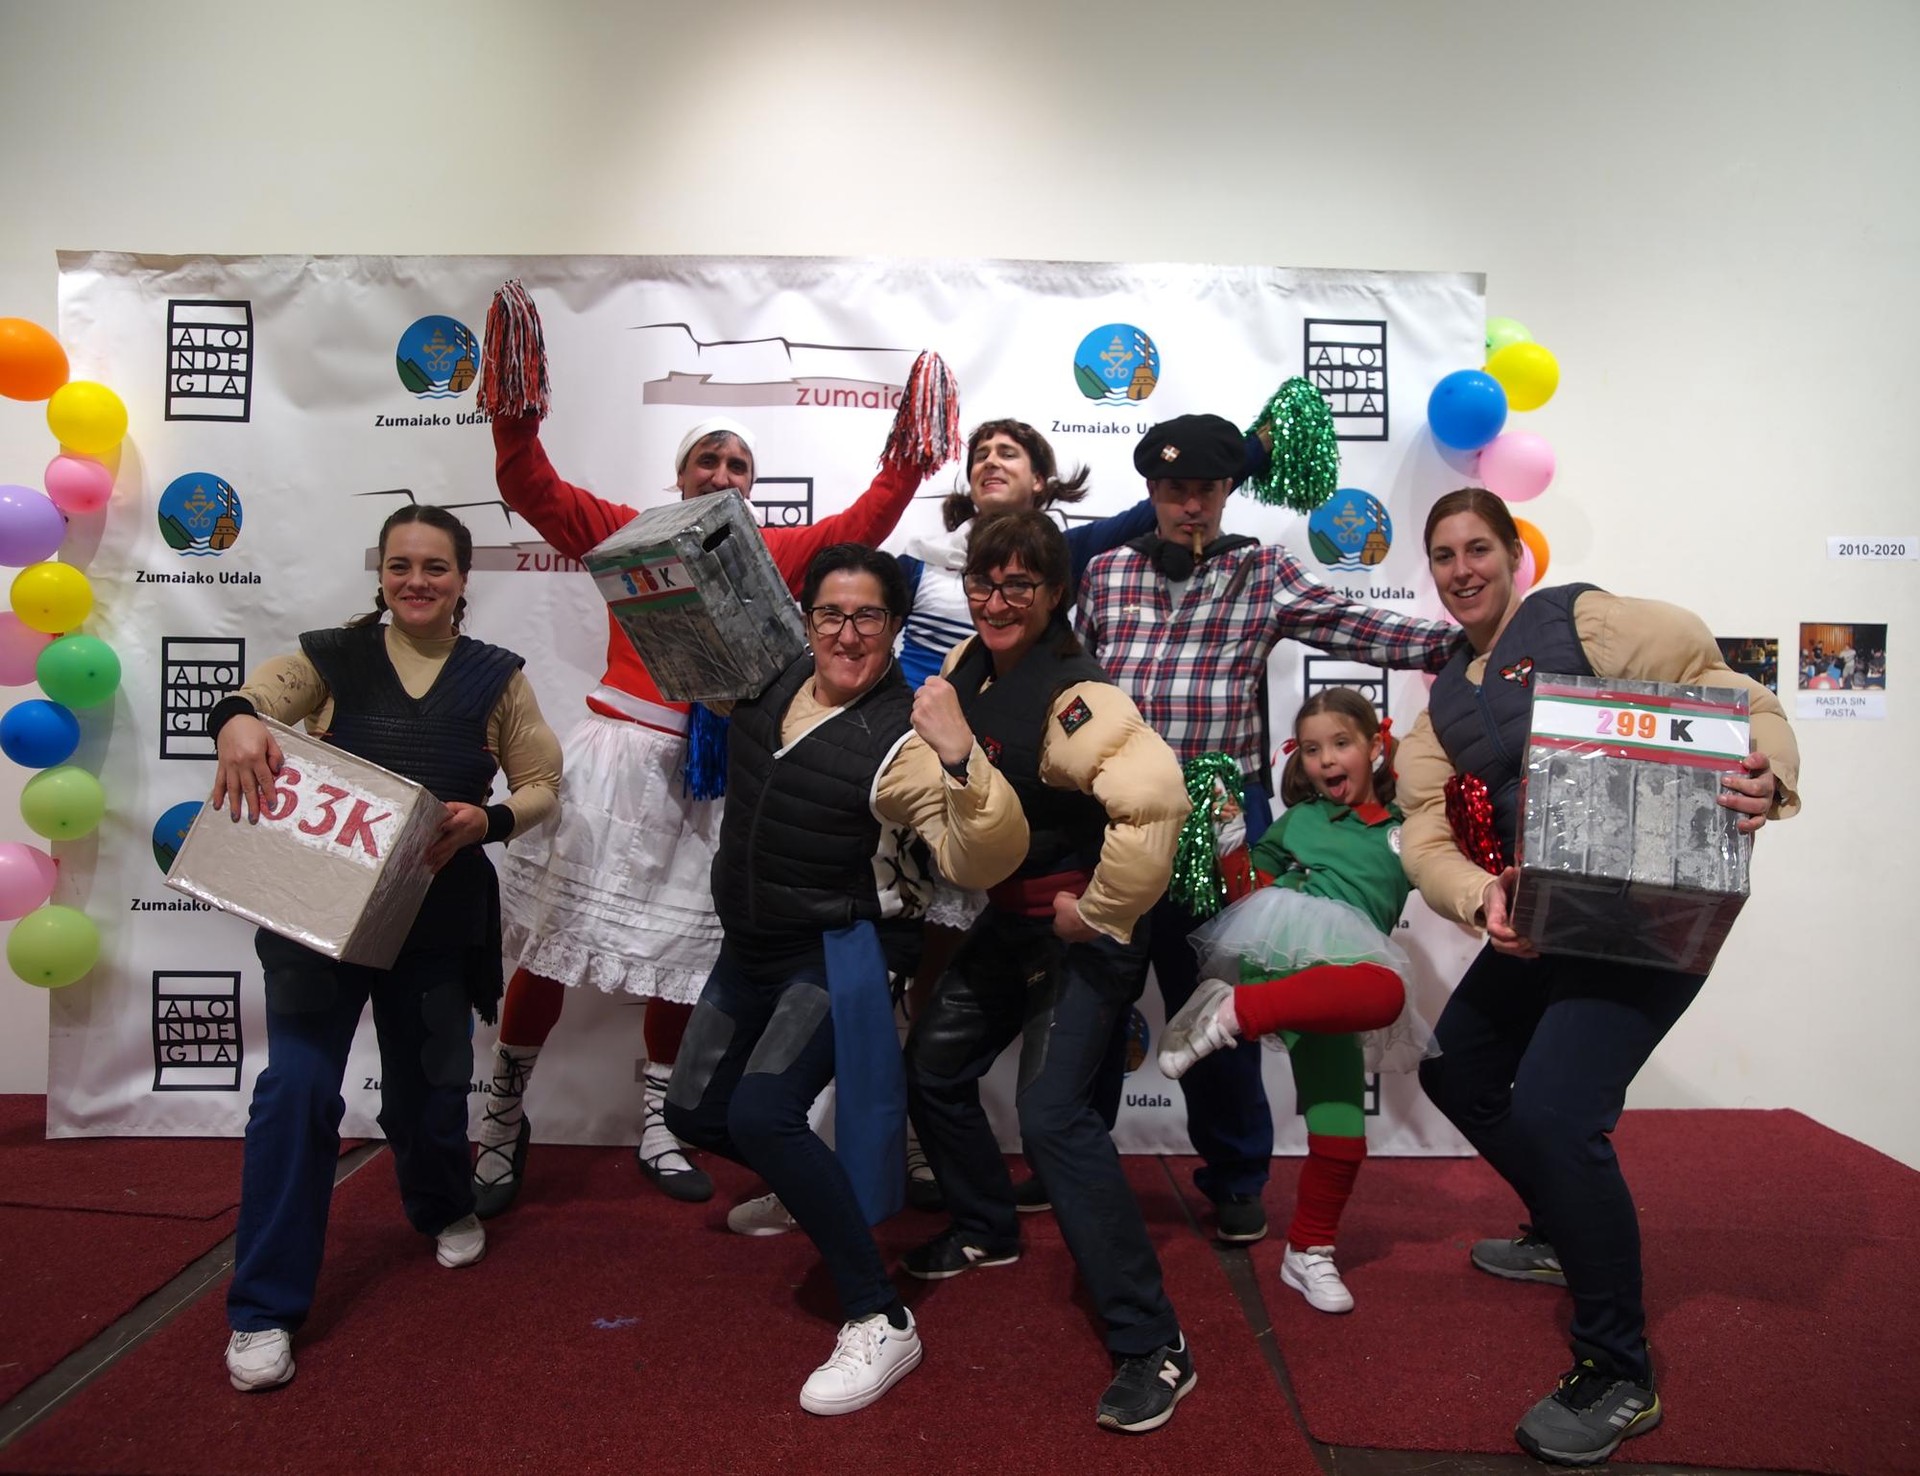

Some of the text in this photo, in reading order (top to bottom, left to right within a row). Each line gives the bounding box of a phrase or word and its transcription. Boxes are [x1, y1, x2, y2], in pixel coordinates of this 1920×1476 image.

[178, 328, 242, 348] ALO
[178, 351, 240, 371] NDE
[1316, 347, 1376, 367] ALO
[176, 374, 239, 394] GIA
[1316, 370, 1376, 390] NDE
[375, 414, 451, 427] Zumaiako
[1051, 420, 1131, 434] Zumaiako
[1838, 544, 1906, 556] 2010-2020
[135, 570, 261, 584] Zumaiako Udala
[1370, 587, 1415, 599] Udala
[174, 666, 233, 685] ALO
[1815, 697, 1866, 706] RASTA SIN
[1825, 708, 1856, 717] PASTA
[1596, 709, 1694, 742] 299 K
[130, 898, 211, 912] Zumaiako
[164, 1000, 229, 1019] ALO
[165, 1022, 229, 1041] NDE
[166, 1044, 231, 1063] GIA
[1126, 1094, 1171, 1107] Udala
